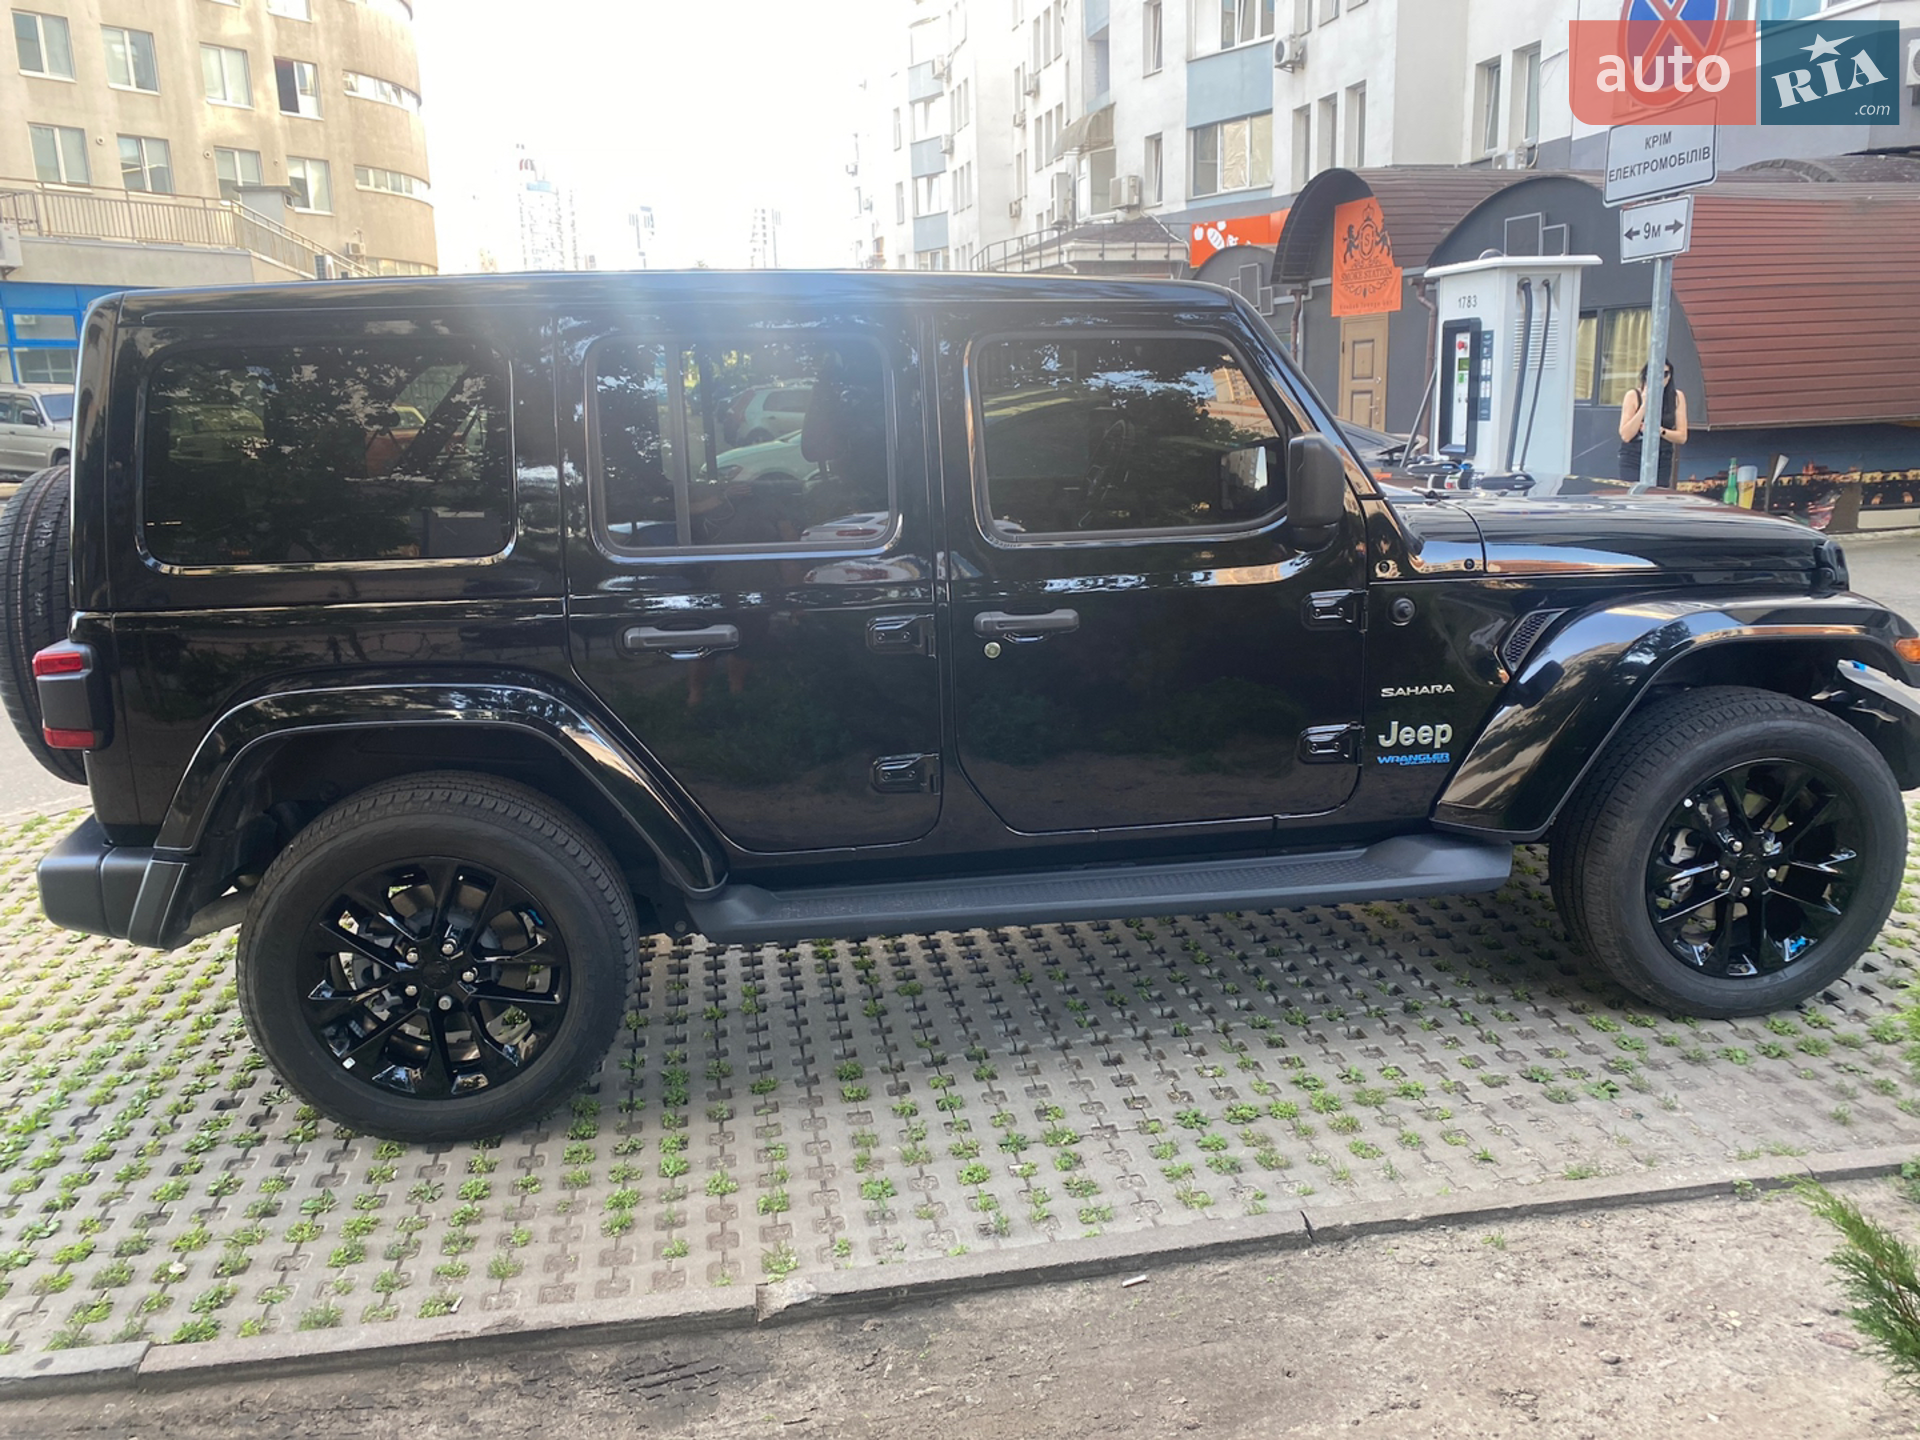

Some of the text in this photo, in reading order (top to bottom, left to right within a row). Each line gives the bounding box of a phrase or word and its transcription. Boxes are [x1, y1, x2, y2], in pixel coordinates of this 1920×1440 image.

[1644, 131, 1672, 150] КРІМ
[1608, 146, 1711, 182] ЕЛЕКТРОМОБІЛІВ
[1363, 266, 1393, 280] STATION
[1458, 295, 1478, 309] 1783
[1380, 684, 1455, 698] SAHARA
[1378, 721, 1453, 749] Jeep
[1377, 752, 1450, 764] WRANGLER
